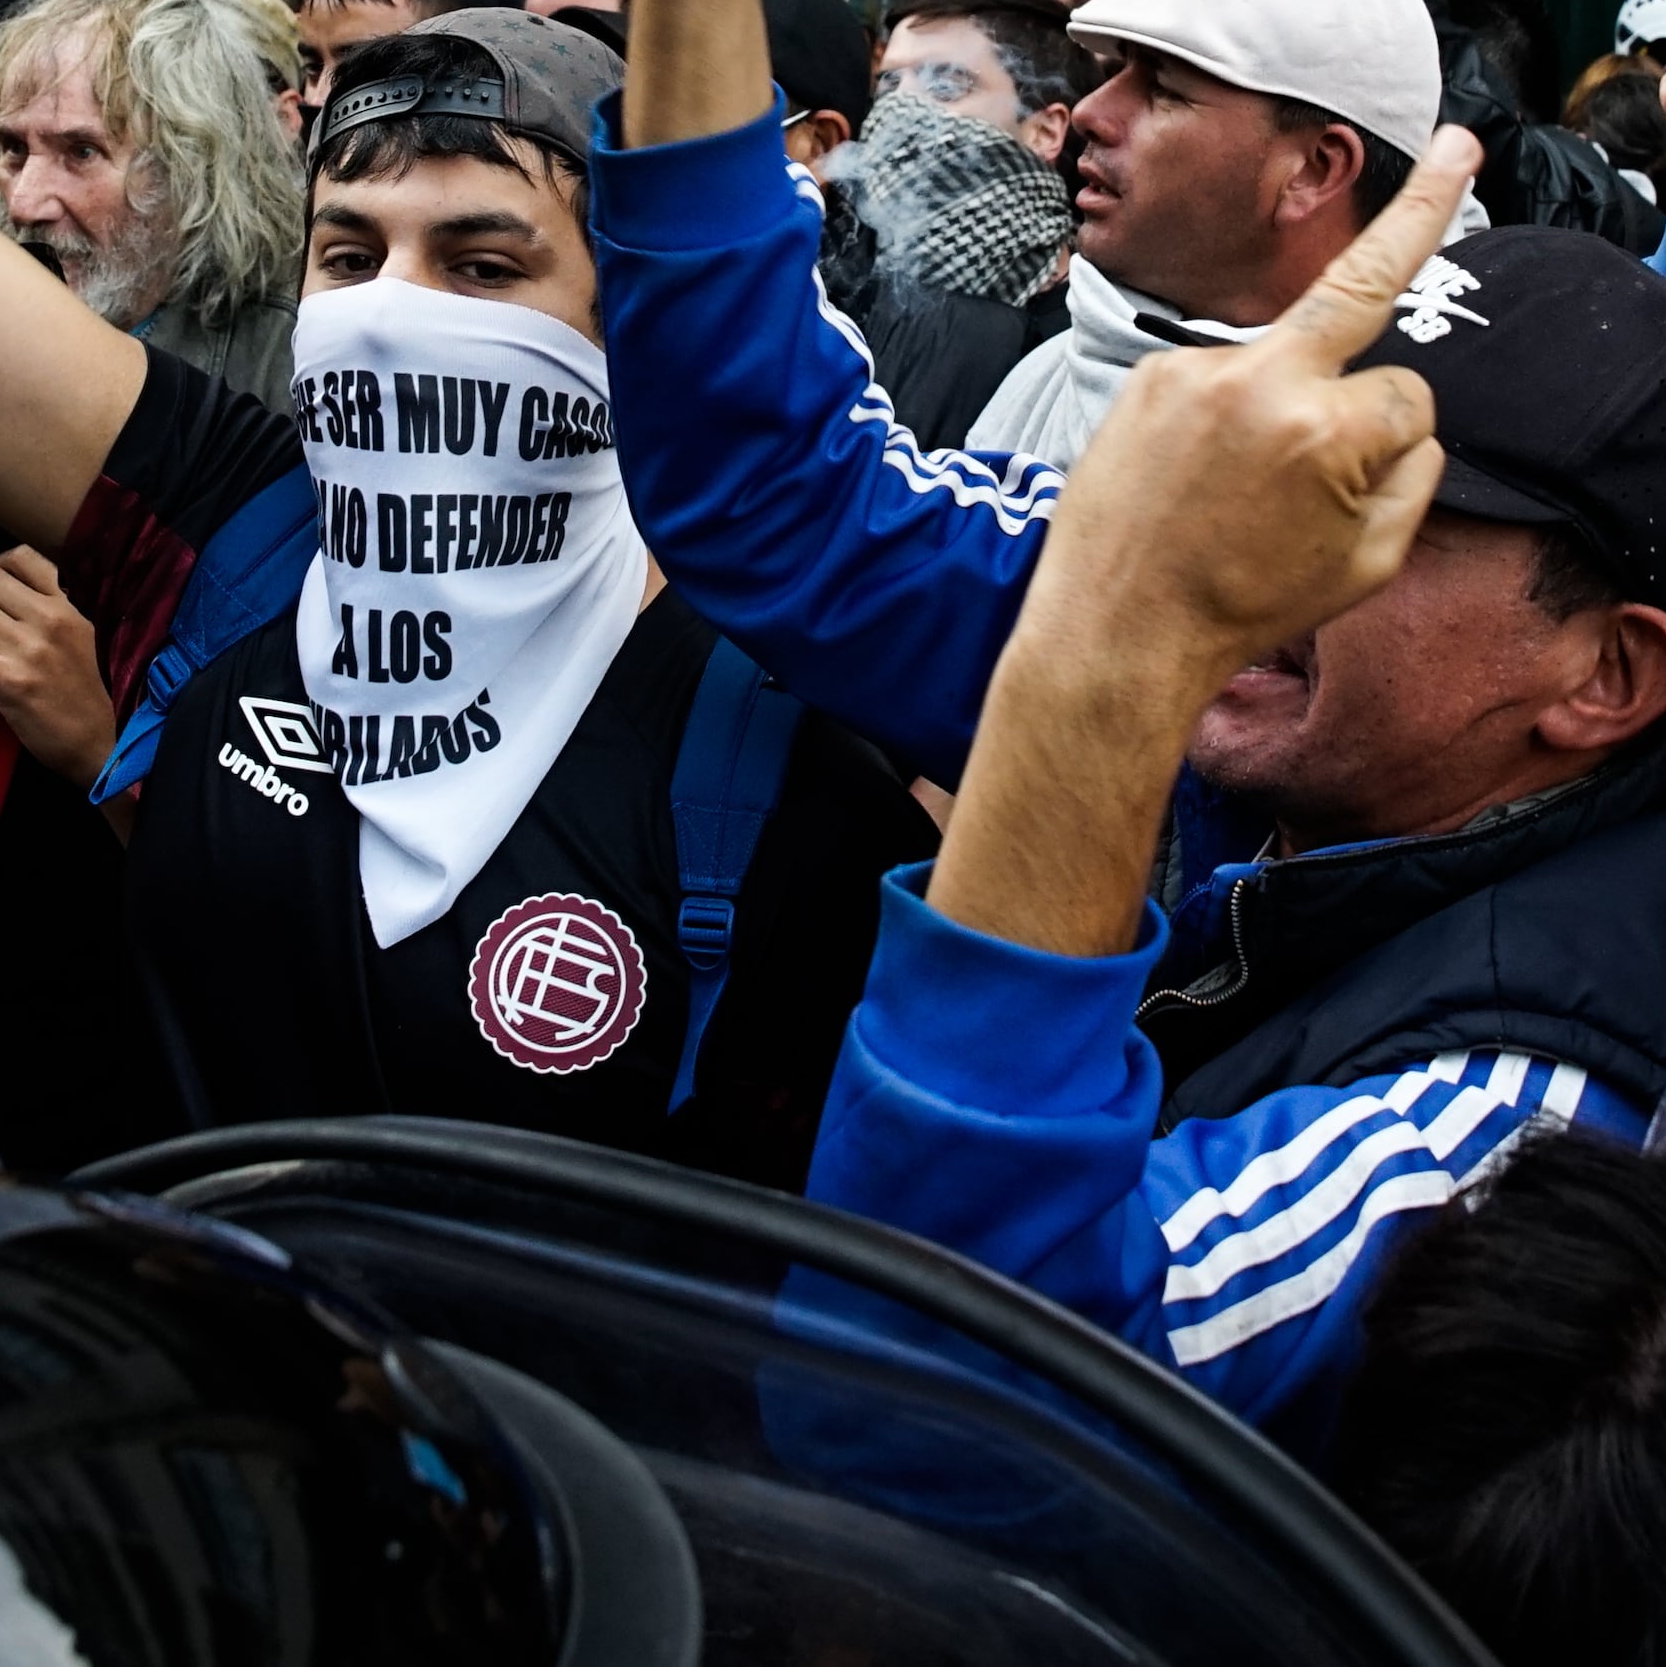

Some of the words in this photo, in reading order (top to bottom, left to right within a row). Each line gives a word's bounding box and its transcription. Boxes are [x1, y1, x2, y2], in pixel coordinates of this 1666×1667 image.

[1408, 254, 1482, 302] IKE
[292, 377, 324, 443] UE
[322, 370, 385, 452] SER
[393, 372, 511, 457] MUY
[330, 483, 367, 569] NO
[376, 490, 573, 575] DEFENDER
[331, 602, 359, 681] A
[367, 608, 453, 684] LOS
[310, 687, 502, 786] BILADOS
[217, 742, 310, 817] umbro
